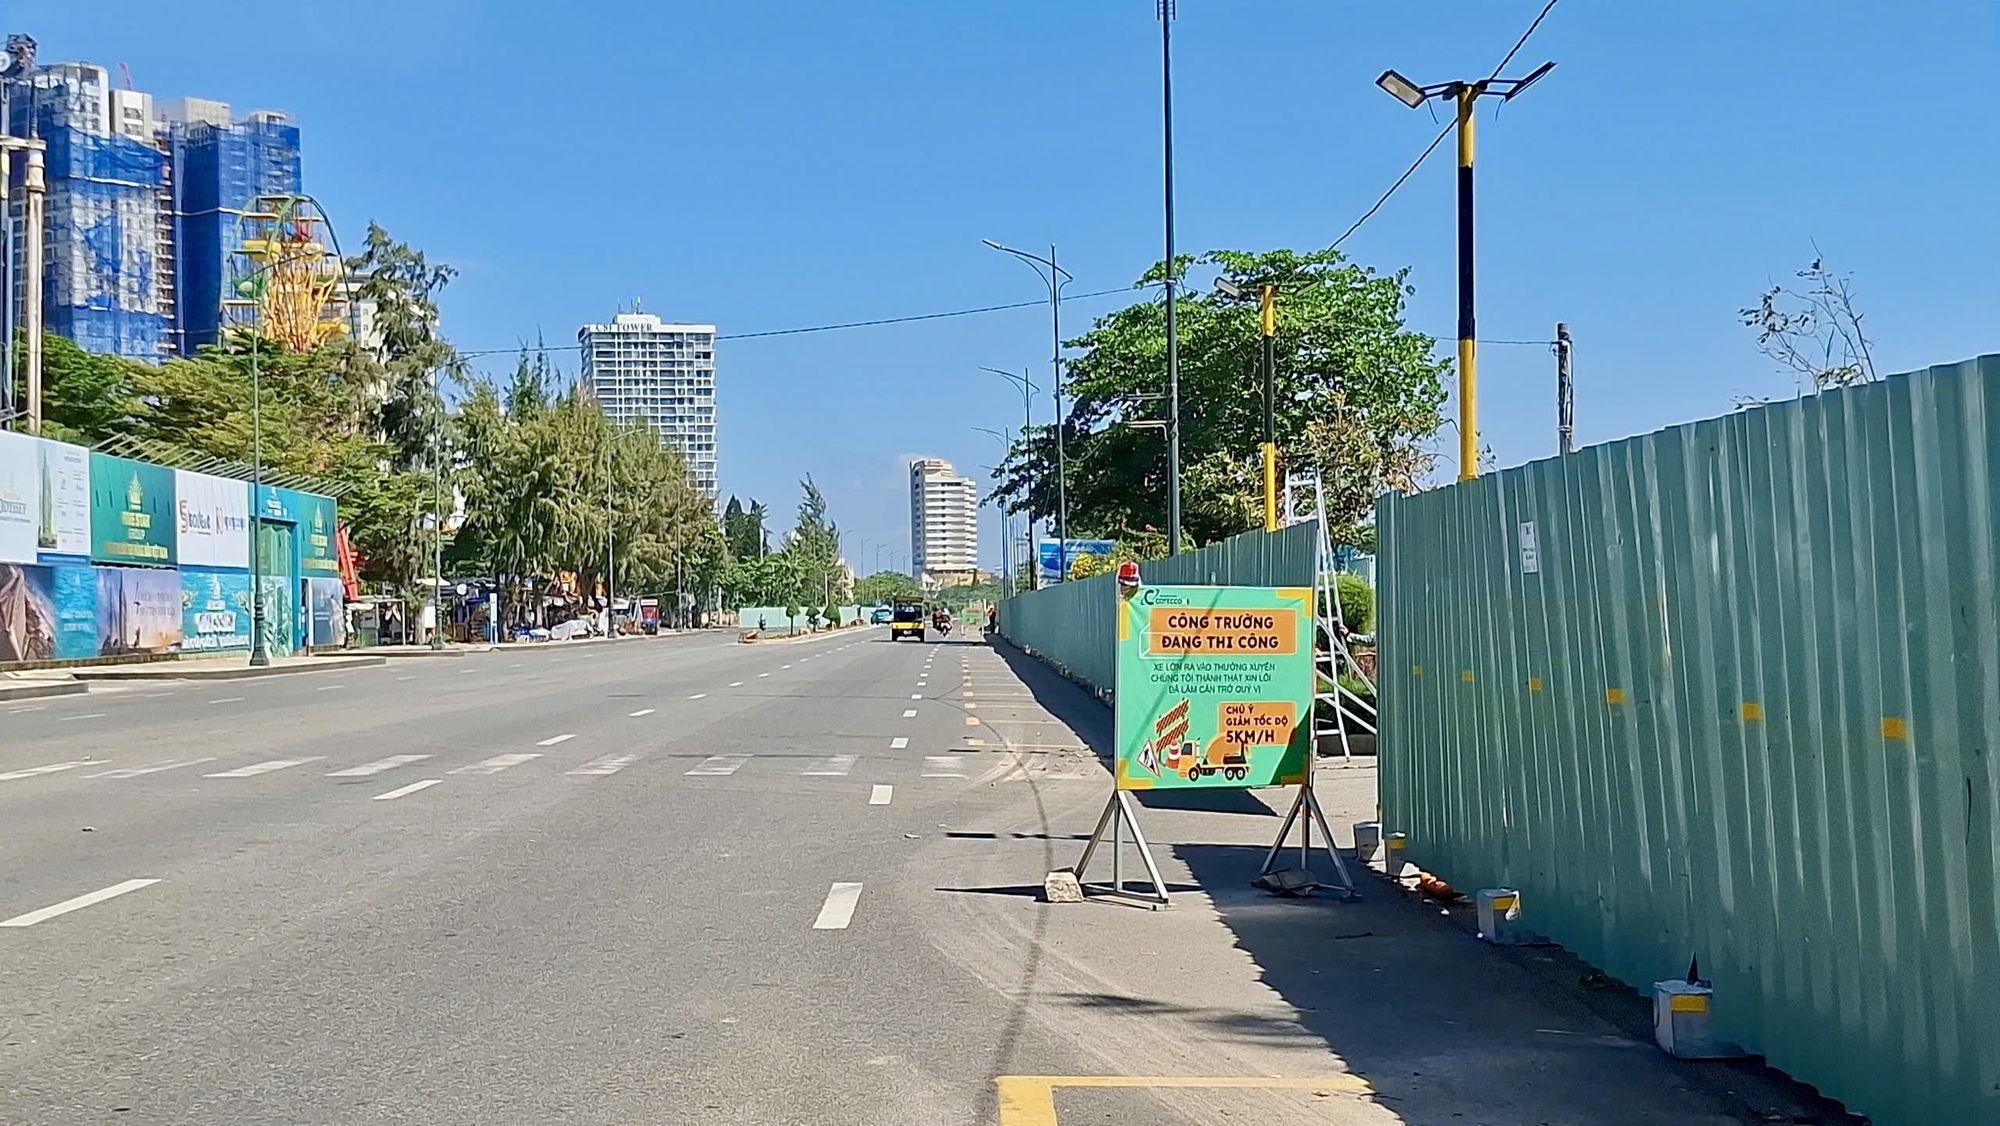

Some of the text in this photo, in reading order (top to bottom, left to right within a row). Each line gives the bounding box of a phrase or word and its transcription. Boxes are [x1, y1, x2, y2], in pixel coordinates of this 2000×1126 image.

[596, 322, 653, 332] CSI TOWER
[1168, 613, 1274, 629] CÔNG TRƯỜNG
[1162, 633, 1279, 649] ĐANG THI CÔNG
[1153, 663, 1164, 672] XE
[1184, 663, 1195, 672] RA
[1248, 703, 1254, 714] Ý
[1253, 713, 1272, 726] TỐC
[1226, 729, 1275, 745] 5KM/H
